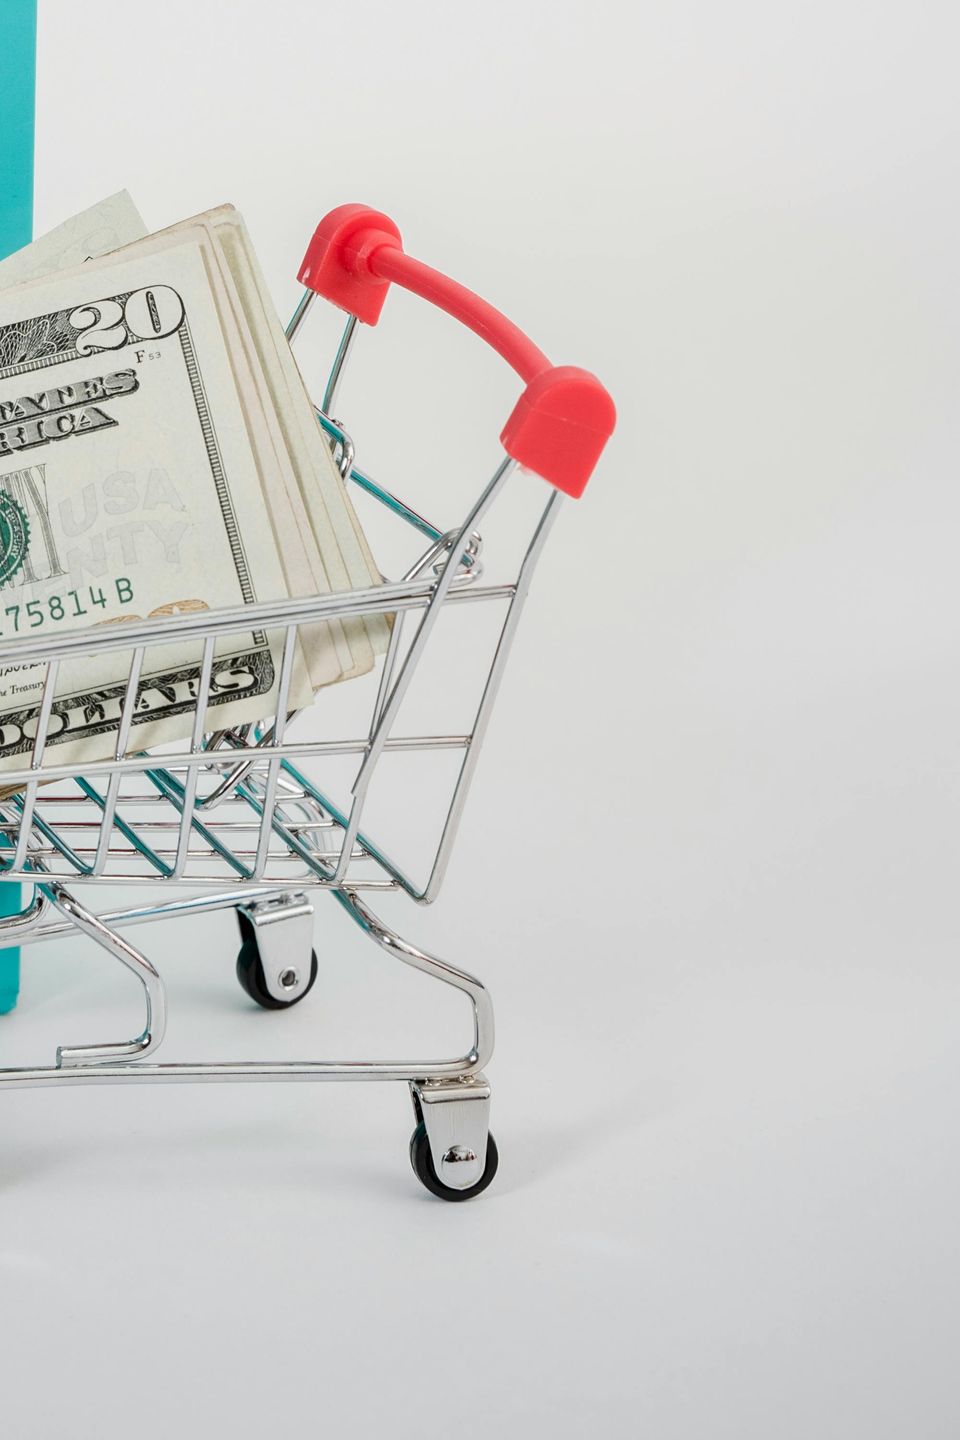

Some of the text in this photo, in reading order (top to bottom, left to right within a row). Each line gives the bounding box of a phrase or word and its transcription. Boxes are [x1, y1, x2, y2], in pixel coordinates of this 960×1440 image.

[68, 284, 186, 358] 20
[57, 467, 188, 538] USA
[114, 577, 135, 604] B
[9, 680, 46, 696] Treasury
